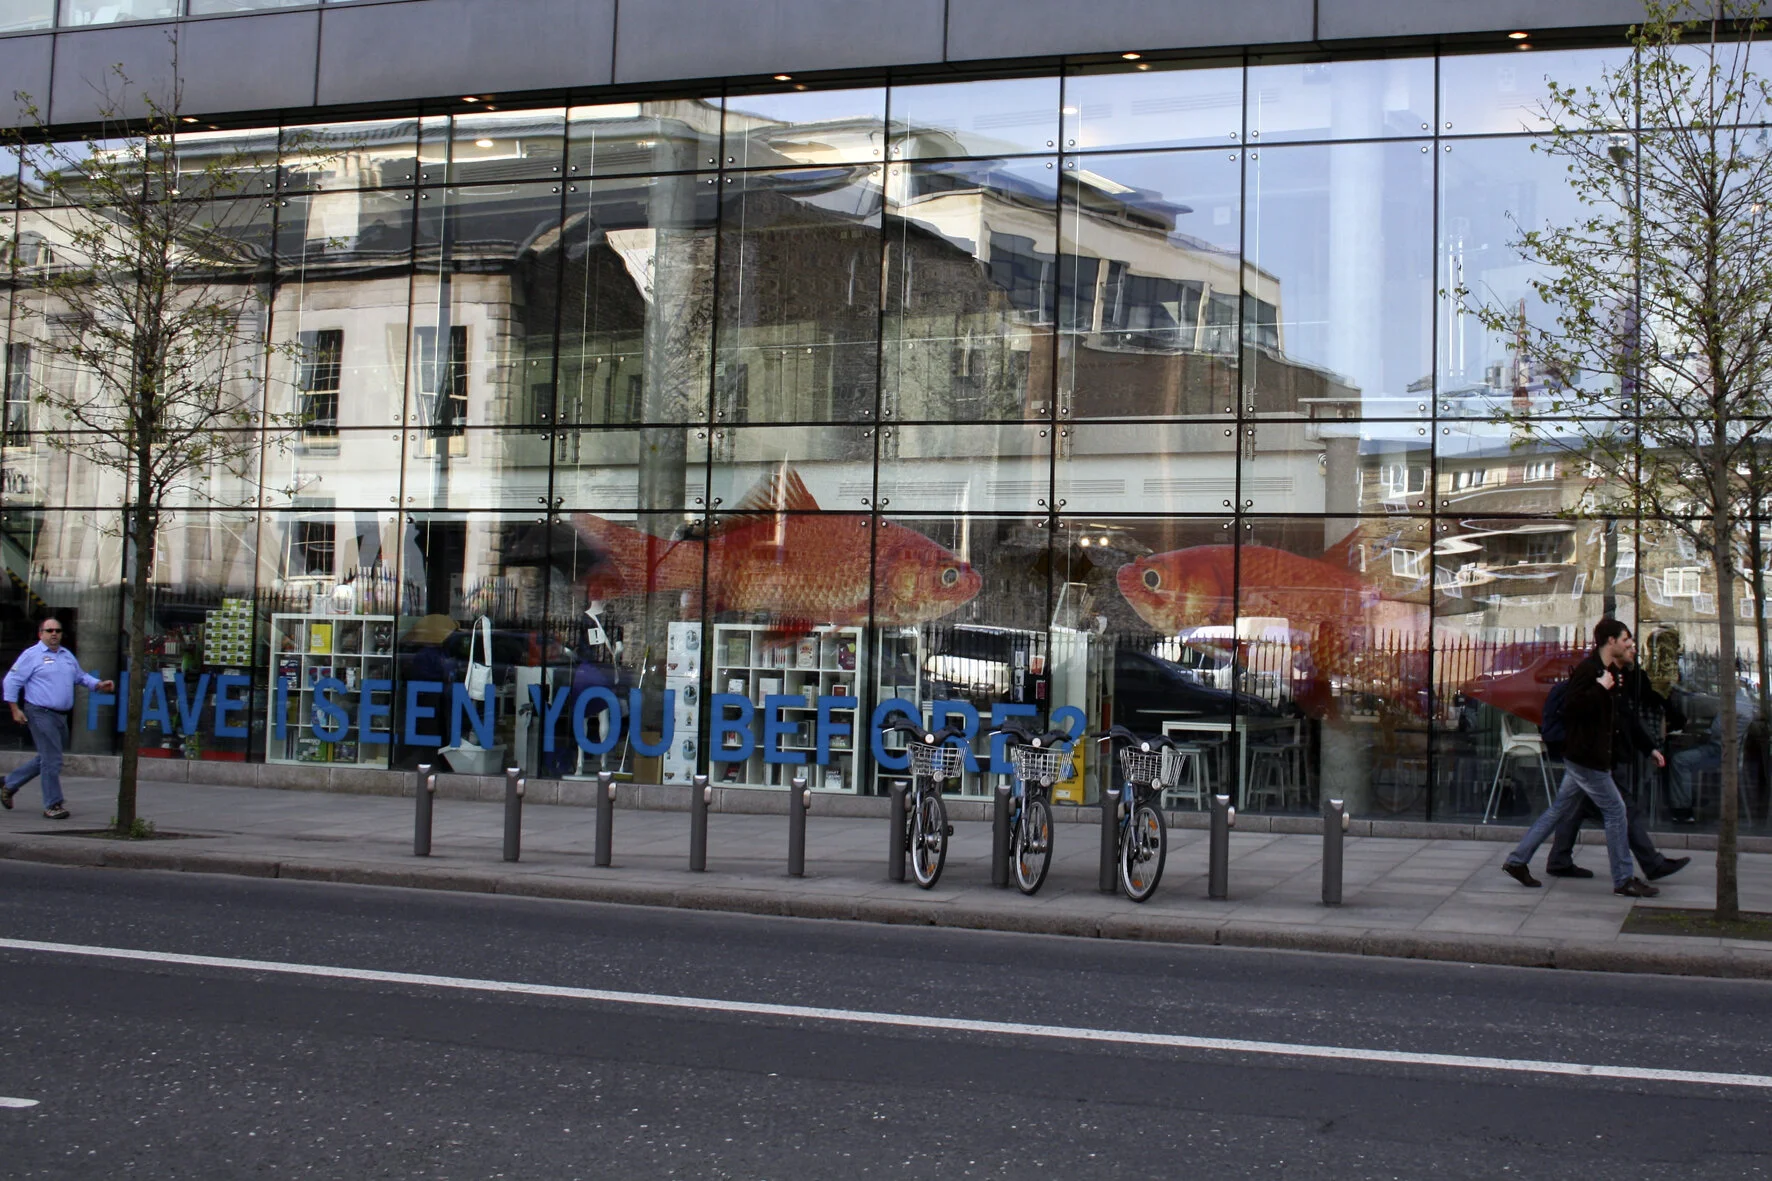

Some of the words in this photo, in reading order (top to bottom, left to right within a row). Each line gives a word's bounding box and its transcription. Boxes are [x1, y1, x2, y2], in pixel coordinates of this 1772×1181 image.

[87, 670, 250, 738] HAVE
[276, 676, 288, 741] I
[311, 677, 496, 750] SEEN
[528, 684, 676, 757] YOU
